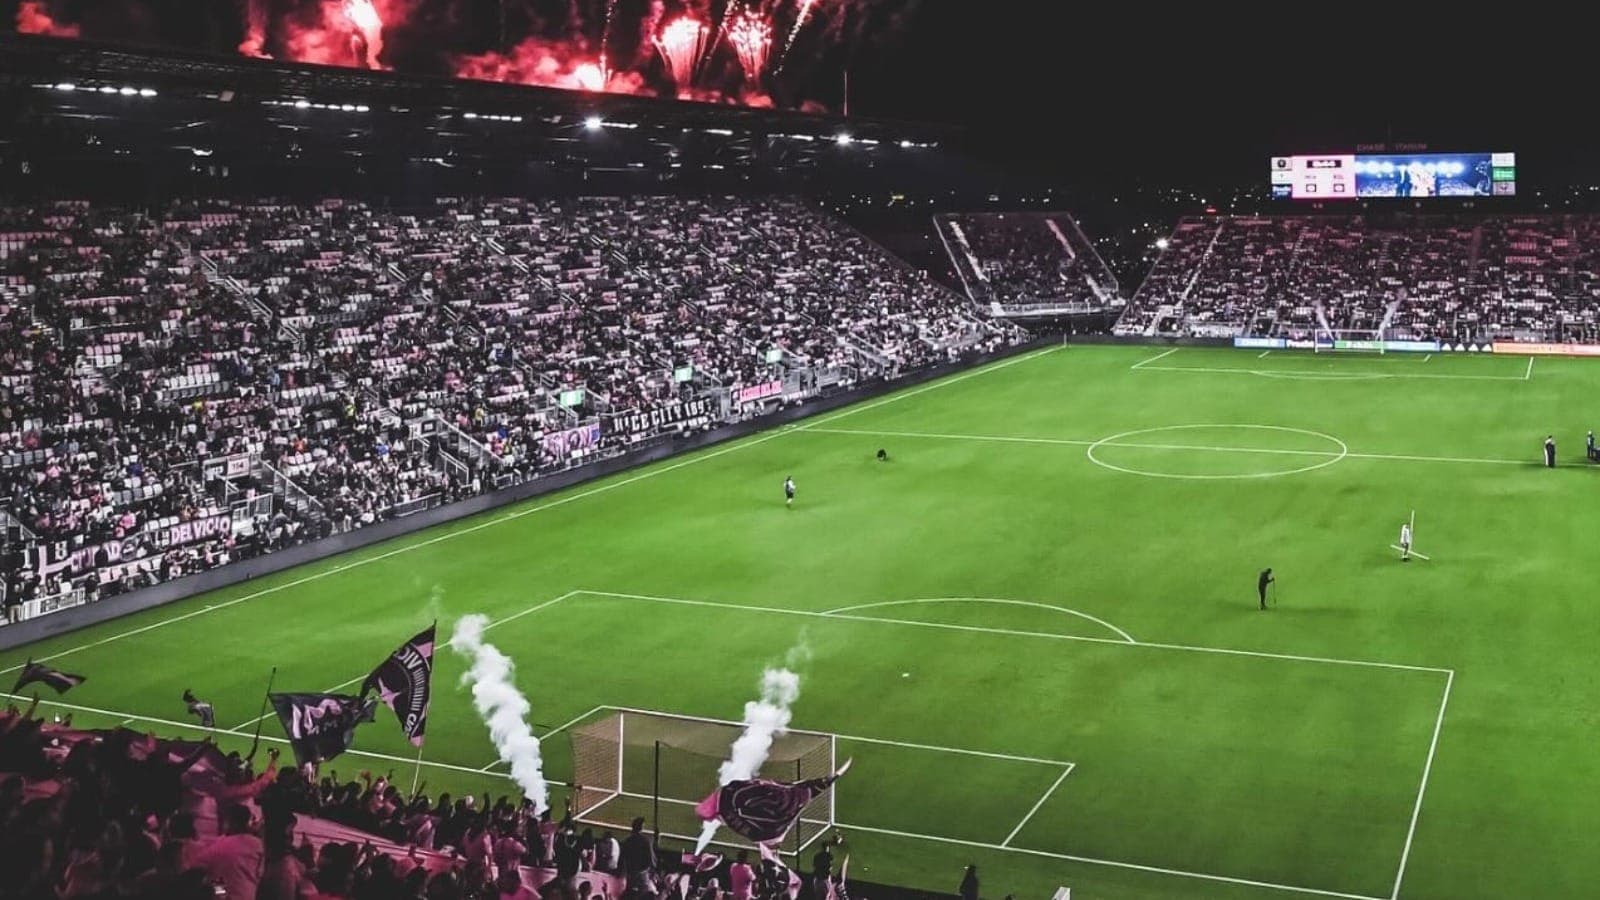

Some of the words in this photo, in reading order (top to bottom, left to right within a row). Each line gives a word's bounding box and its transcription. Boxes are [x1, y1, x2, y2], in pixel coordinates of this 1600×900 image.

[650, 404, 683, 426] CITY
[170, 522, 193, 546] DEL
[192, 515, 231, 541] VICIO
